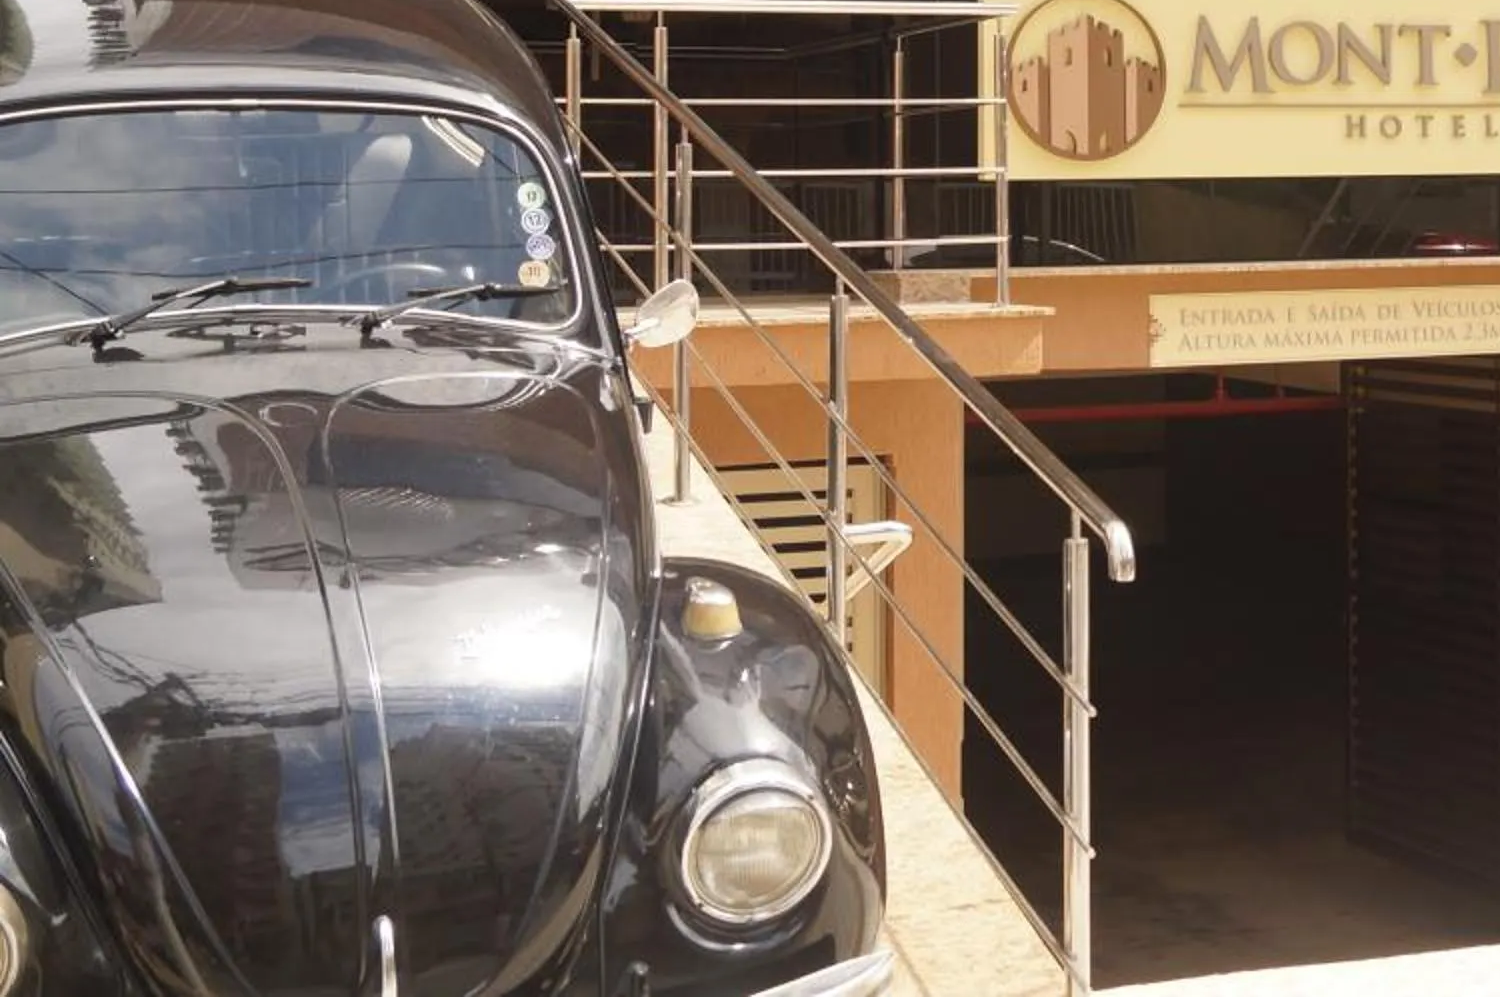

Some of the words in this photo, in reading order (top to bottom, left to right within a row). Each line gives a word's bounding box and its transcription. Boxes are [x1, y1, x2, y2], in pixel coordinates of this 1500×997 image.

[1344, 114, 1500, 139] HOTEL
[1179, 308, 1275, 326] ENTRADA
[1287, 307, 1297, 323] E
[1308, 302, 1366, 322] SAÍDA
[1377, 304, 1400, 319] DE
[1178, 332, 1256, 352] ALTURA
[1351, 324, 1456, 345] PERMITIDA
